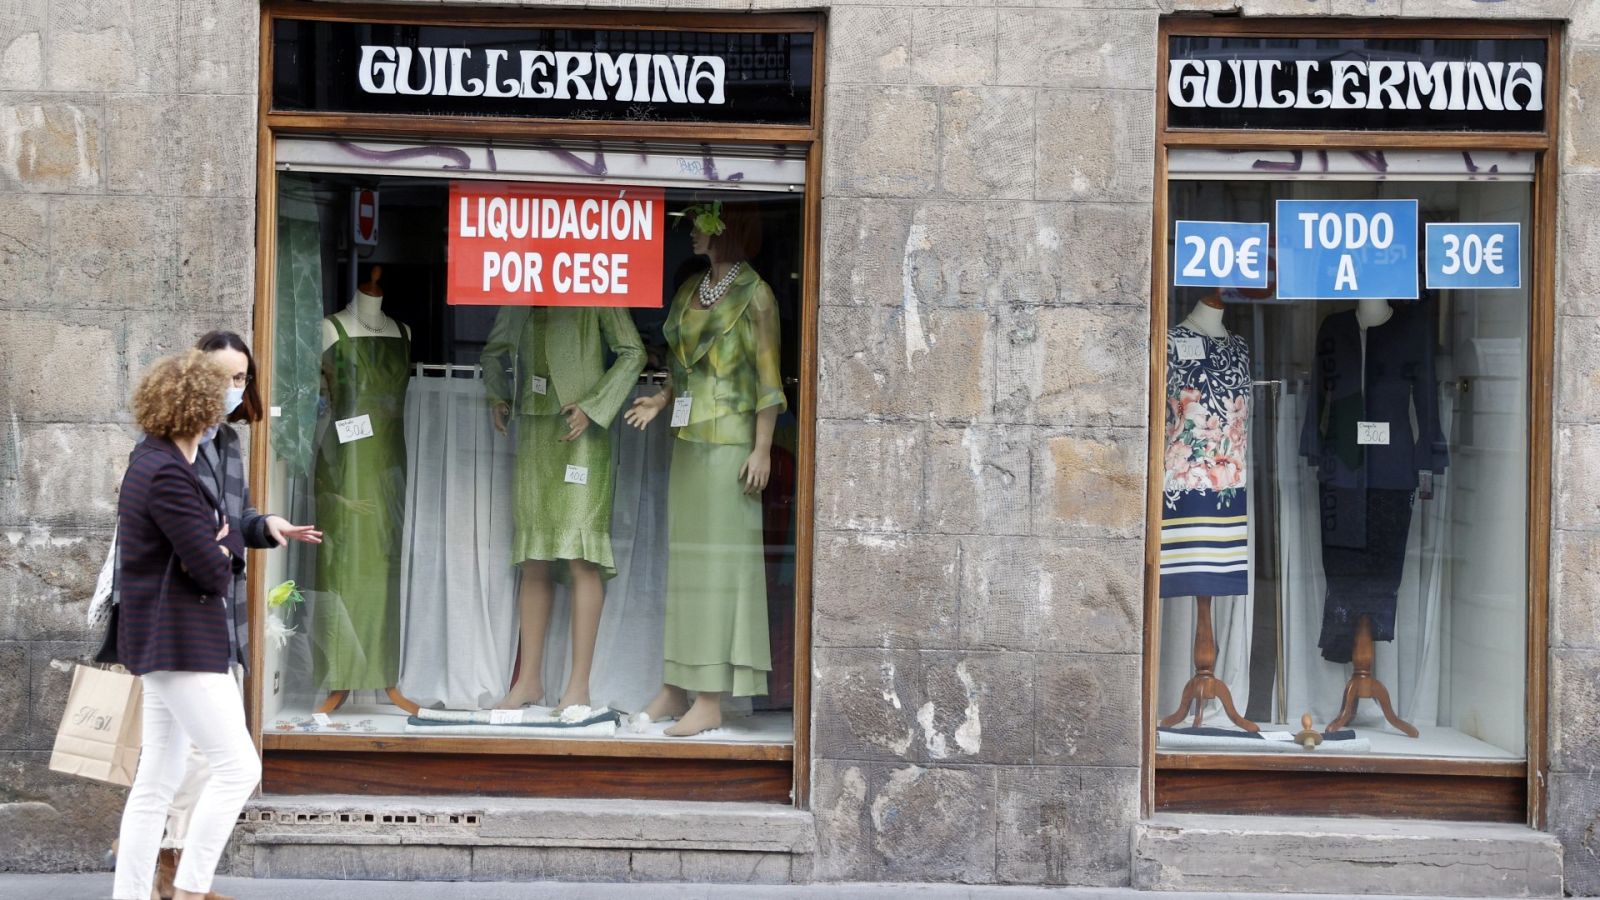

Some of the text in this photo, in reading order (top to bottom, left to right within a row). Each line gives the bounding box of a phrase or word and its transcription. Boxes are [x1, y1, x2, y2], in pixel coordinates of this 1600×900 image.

[359, 45, 726, 104] GUILLERMINA
[1168, 59, 1543, 111] GUILLERMINA
[460, 190, 653, 242] LIQUIDACIÓN
[1298, 212, 1394, 249] TODO
[482, 251, 629, 294] POR CESE
[1182, 235, 1261, 279] 20€
[1334, 254, 1359, 291] A
[1442, 234, 1505, 275] 30€
